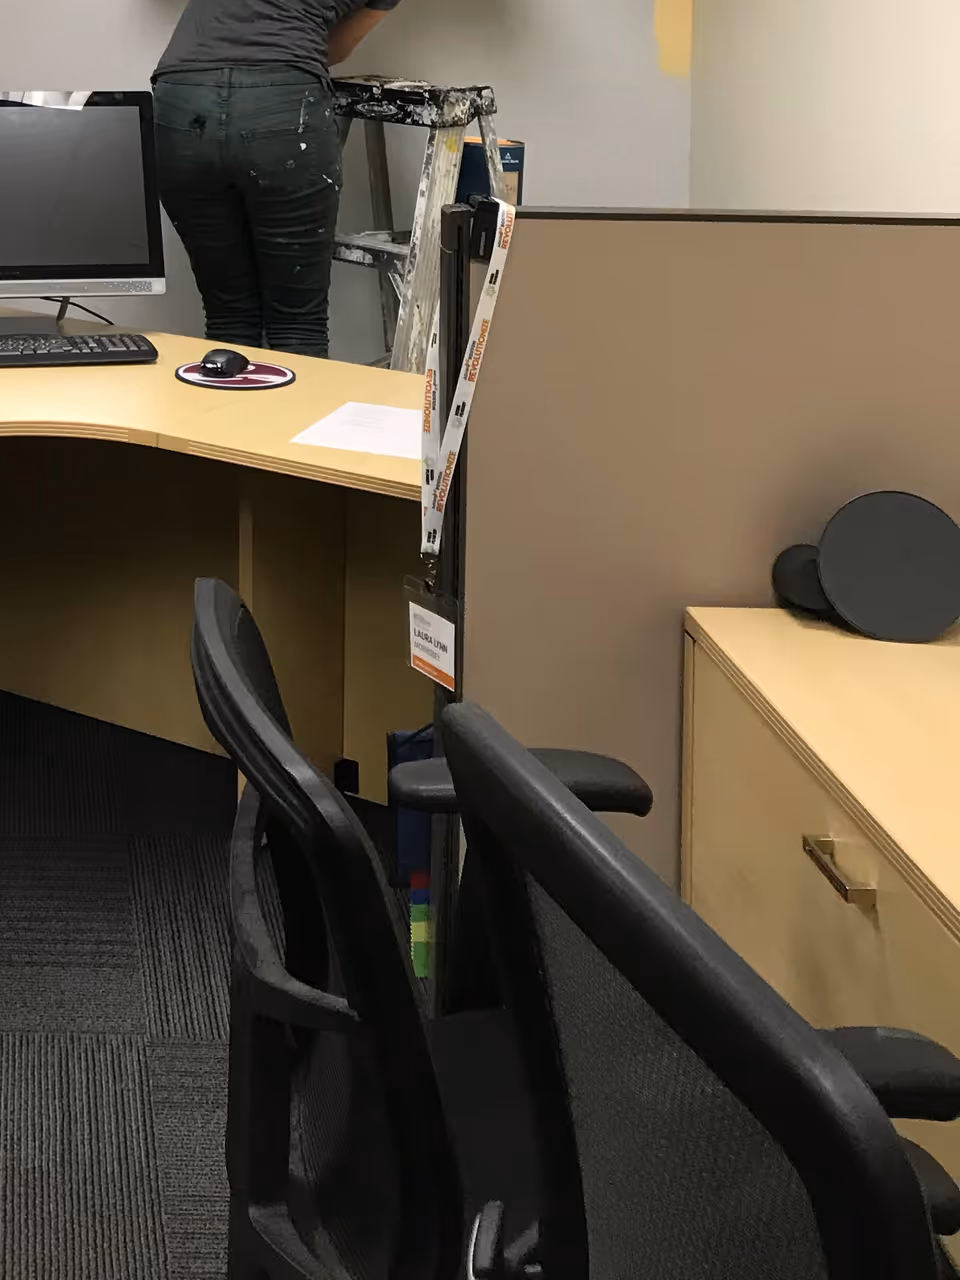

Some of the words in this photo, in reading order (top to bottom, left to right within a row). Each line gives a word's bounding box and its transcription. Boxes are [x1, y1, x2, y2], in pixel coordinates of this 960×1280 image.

[467, 318, 490, 383] REVOLUTIONIZE
[423, 368, 433, 434] REVOLUTIONIZE
[435, 450, 457, 513] REVOLUTIONIZE
